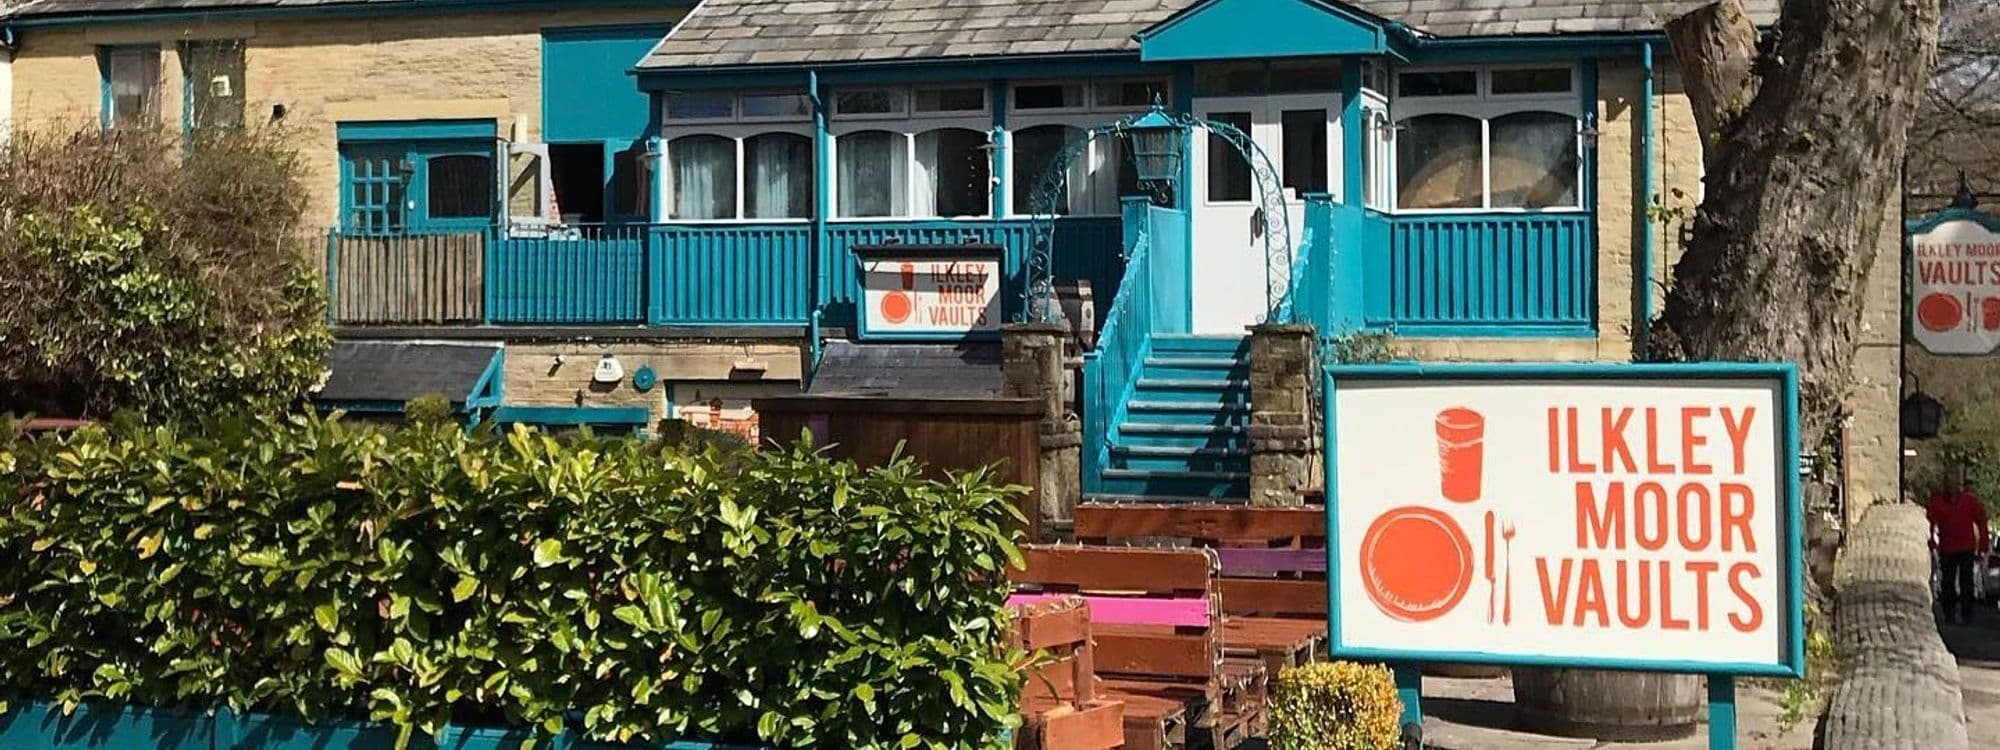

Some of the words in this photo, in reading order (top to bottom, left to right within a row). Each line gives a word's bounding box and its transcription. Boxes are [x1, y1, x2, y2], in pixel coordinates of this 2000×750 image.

[1918, 243, 1961, 257] ILKLEY
[930, 262, 985, 284] ILKLEY
[1918, 260, 2000, 286] VAULTS
[938, 284, 986, 305] MOOR
[928, 306, 987, 327] VAULTS
[1547, 406, 1756, 475] ILKLEY
[1575, 481, 1758, 553] MOOR
[1535, 556, 1764, 634] VAULTS
